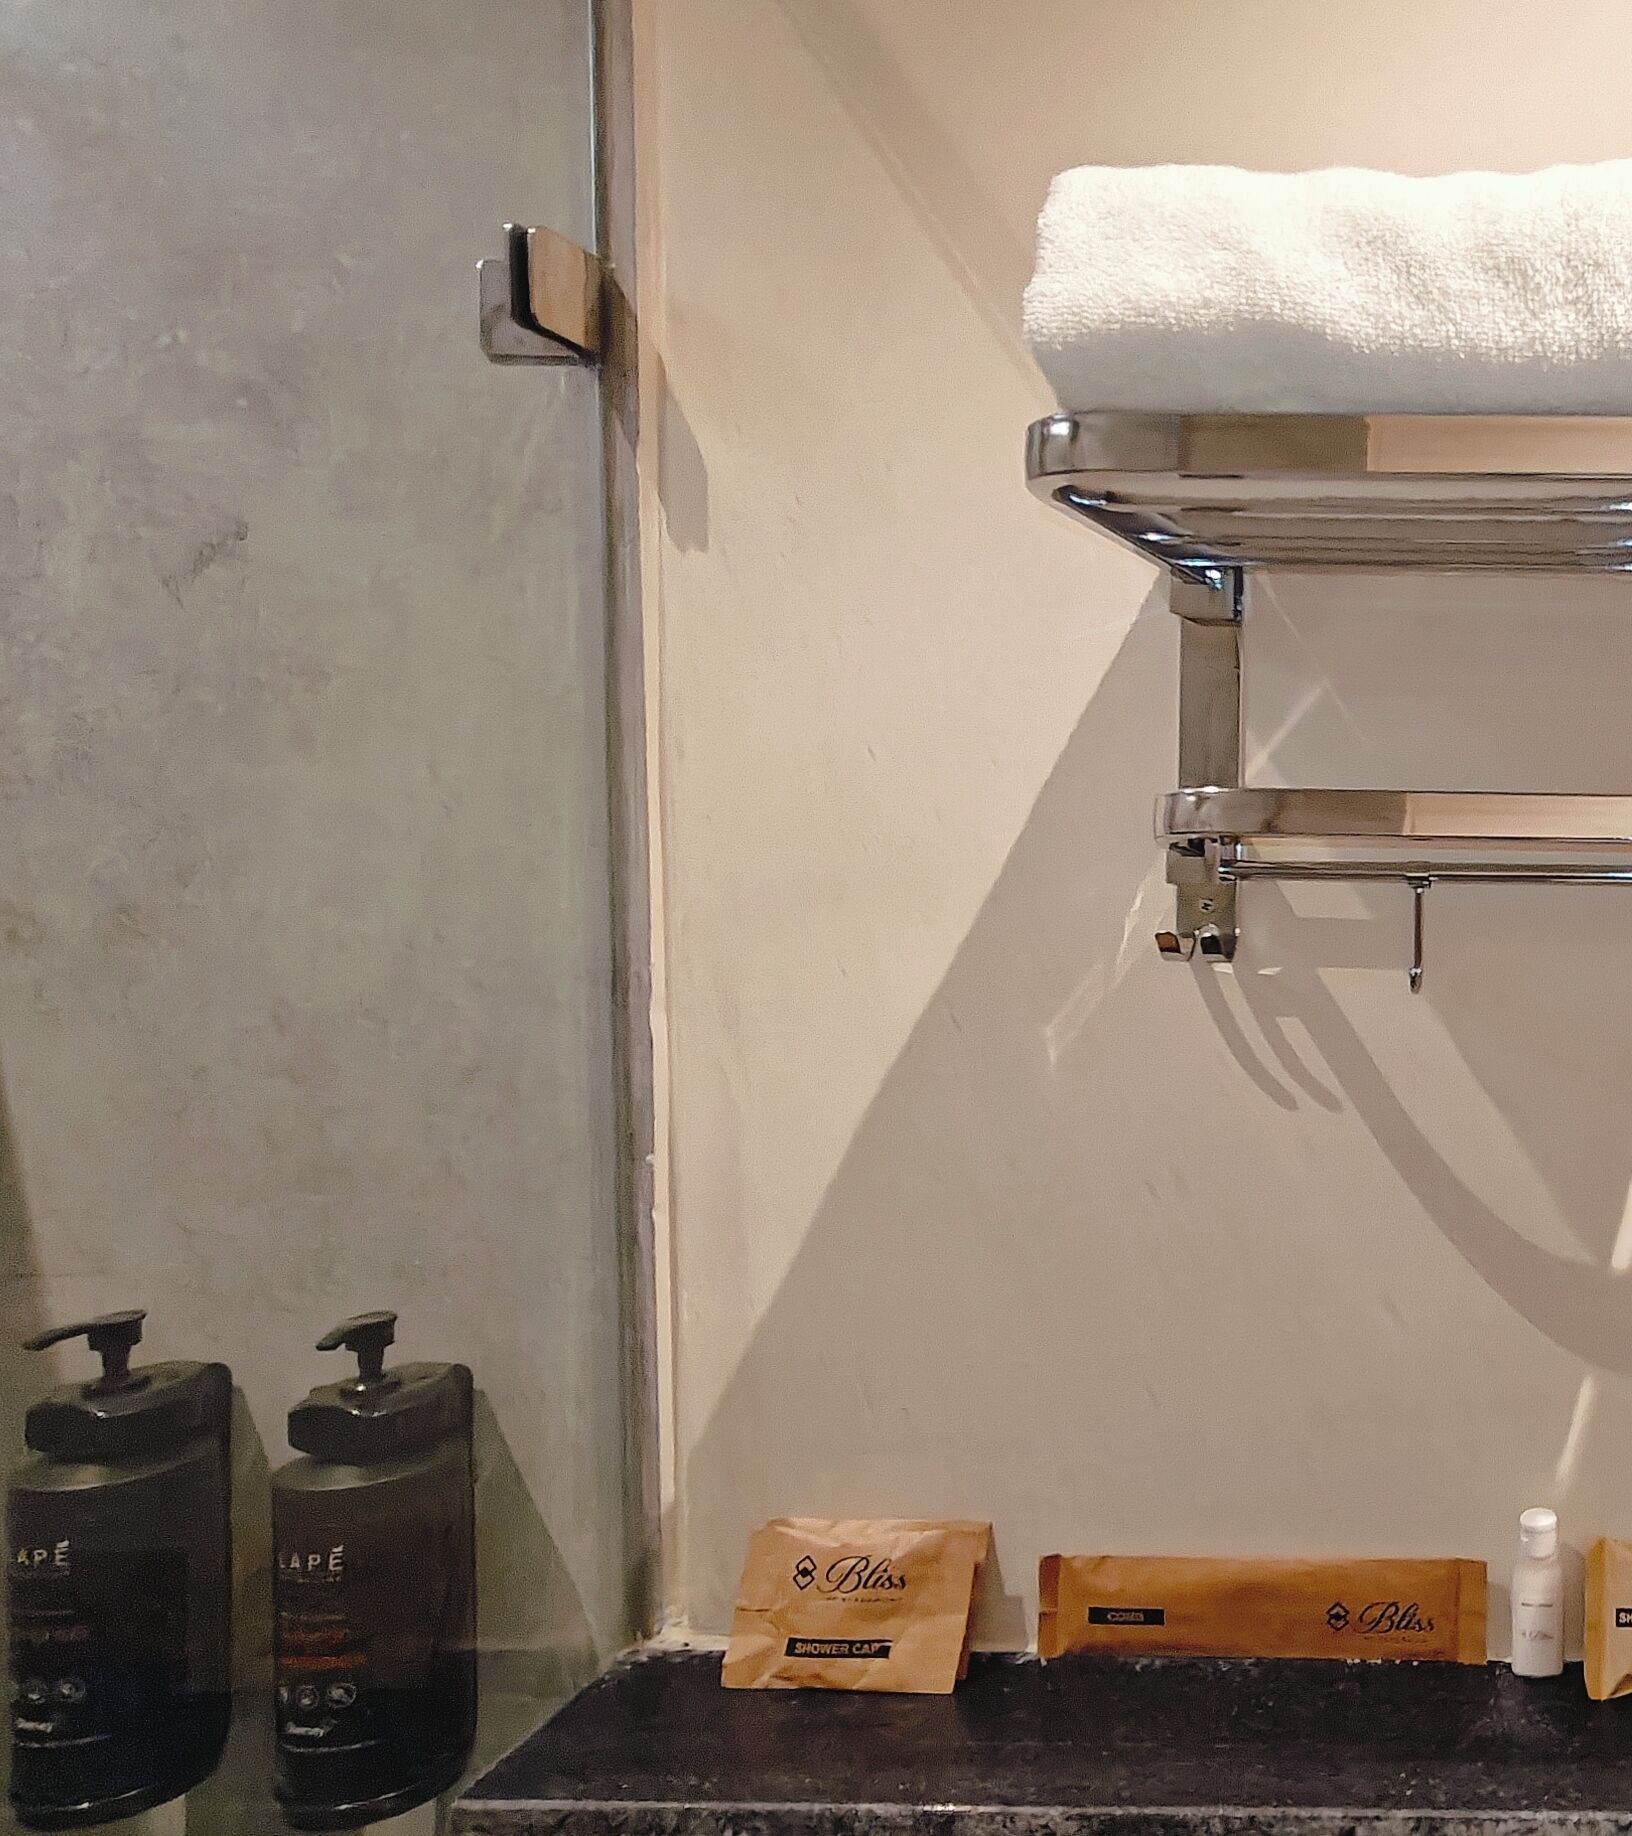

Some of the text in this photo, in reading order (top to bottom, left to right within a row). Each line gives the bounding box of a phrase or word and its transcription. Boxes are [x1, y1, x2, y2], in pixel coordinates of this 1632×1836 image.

[816, 1554, 907, 1594] Bliss
[1352, 1601, 1435, 1633] Bliss
[794, 1642, 850, 1655] SHOWER
